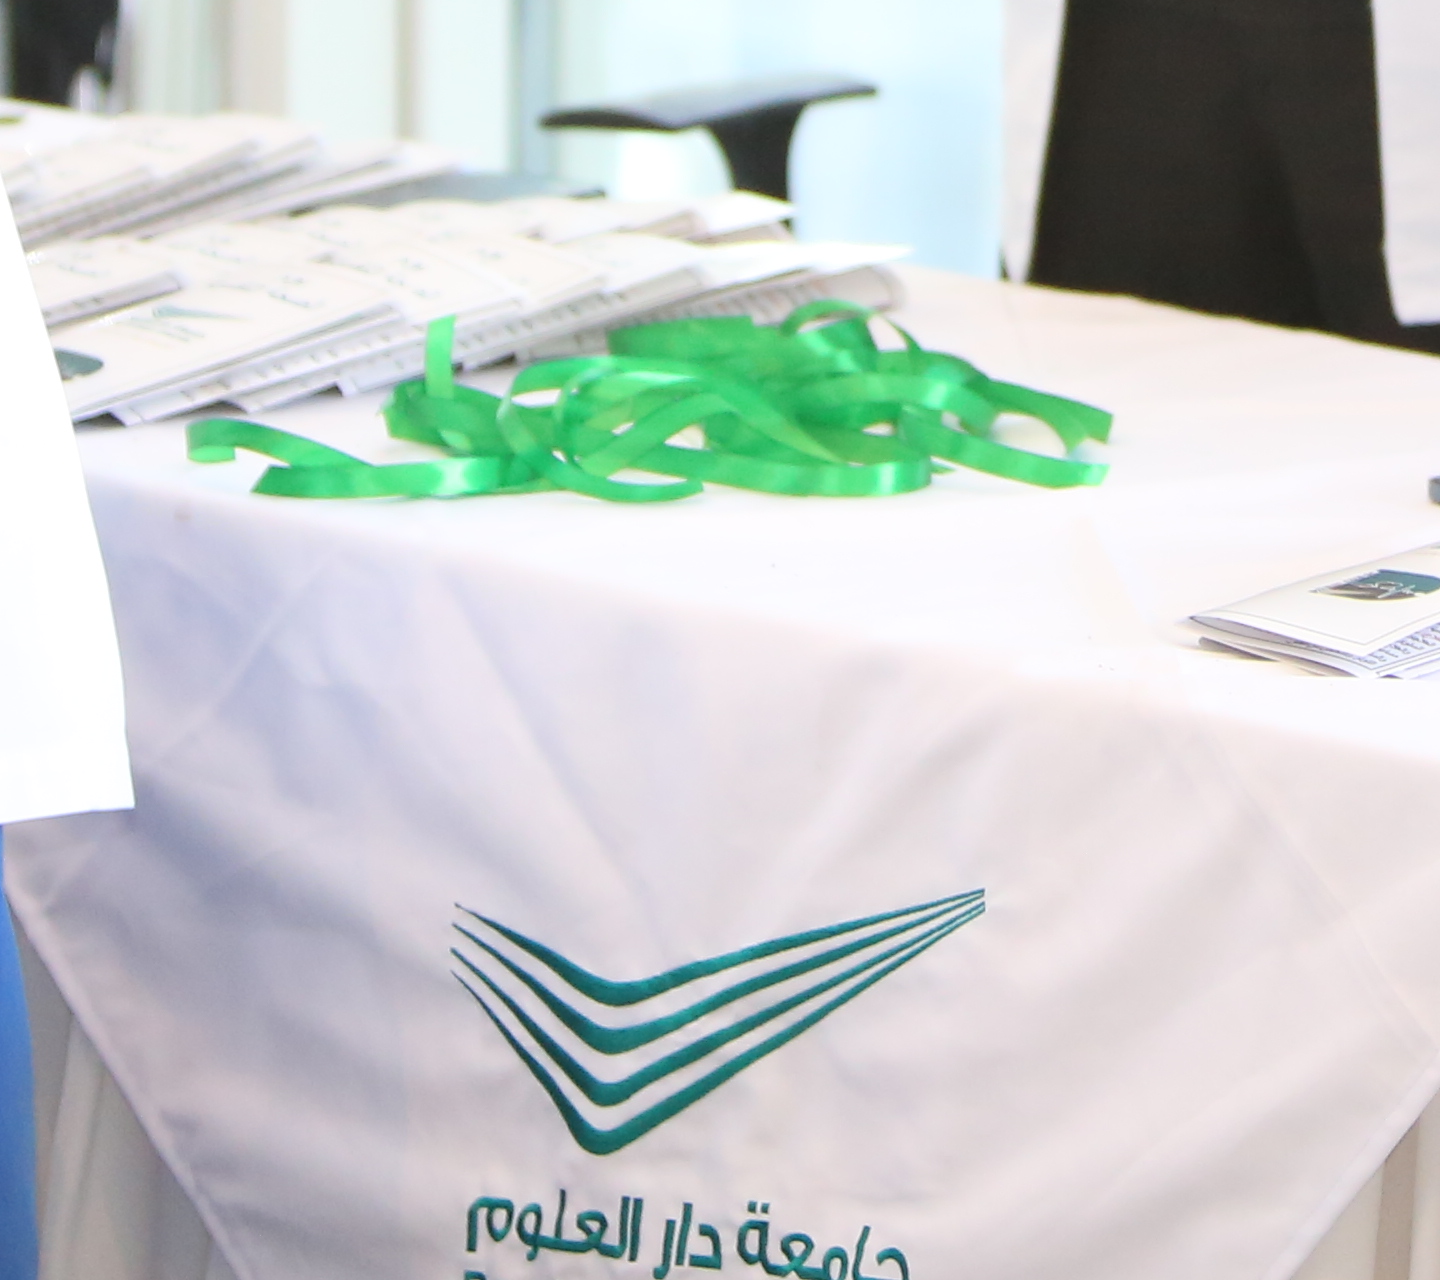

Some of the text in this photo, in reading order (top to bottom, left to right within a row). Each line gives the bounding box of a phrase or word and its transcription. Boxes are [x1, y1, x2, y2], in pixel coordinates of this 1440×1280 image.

[465, 1188, 910, 1280] جامعة دار العلوم
